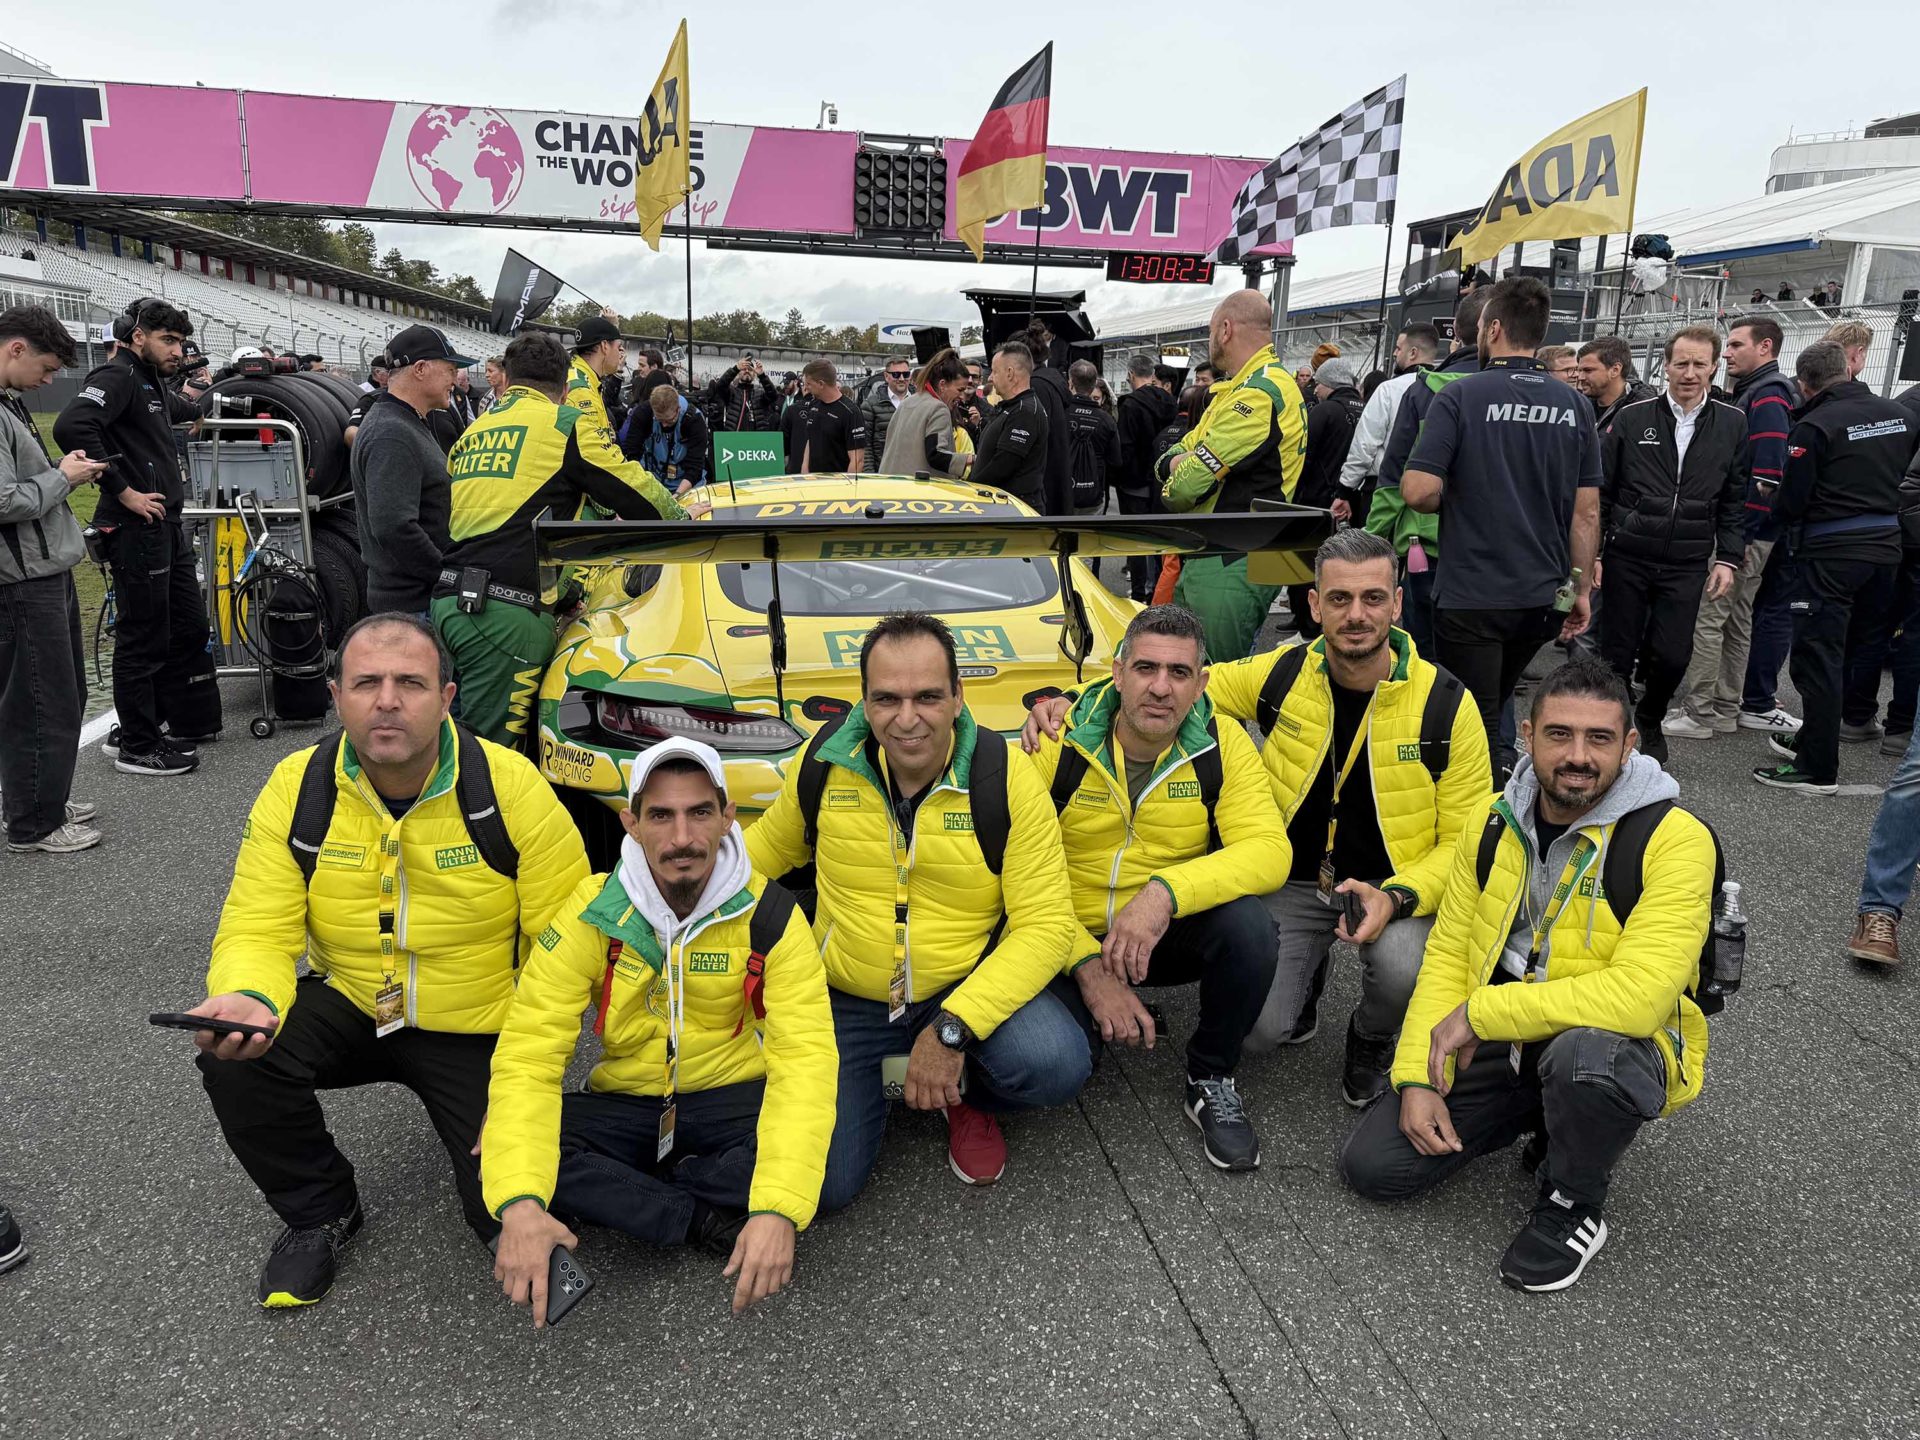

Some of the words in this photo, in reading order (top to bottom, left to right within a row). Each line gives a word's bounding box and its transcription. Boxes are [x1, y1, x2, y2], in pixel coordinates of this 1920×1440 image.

[535, 120, 704, 161] CHANE
[536, 155, 568, 169] THE
[571, 158, 705, 192] WOD
[1233, 402, 1253, 416] OMP
[1486, 403, 1576, 427] MEDIA
[1847, 418, 1904, 433] SCHUBERT
[1851, 426, 1906, 440] MOTORSPORT
[738, 450, 777, 462] DEKRA
[1195, 446, 1222, 472] DTM
[453, 452, 512, 475] FILTER
[756, 501, 870, 518] DTM
[879, 501, 984, 515] 2024
[488, 584, 535, 603] sparco
[835, 629, 998, 651] MN
[555, 744, 595, 767] WINWARD
[1400, 752, 1421, 760] FILT
[553, 759, 592, 782] RACING
[1169, 782, 1198, 790] MANN
[1169, 788, 1199, 797] FILTER
[324, 848, 362, 858] MOTORSPORT
[437, 845, 475, 858] MANN
[438, 855, 476, 867] FILTER
[691, 953, 727, 963] MANN
[691, 961, 727, 971] FILTER
